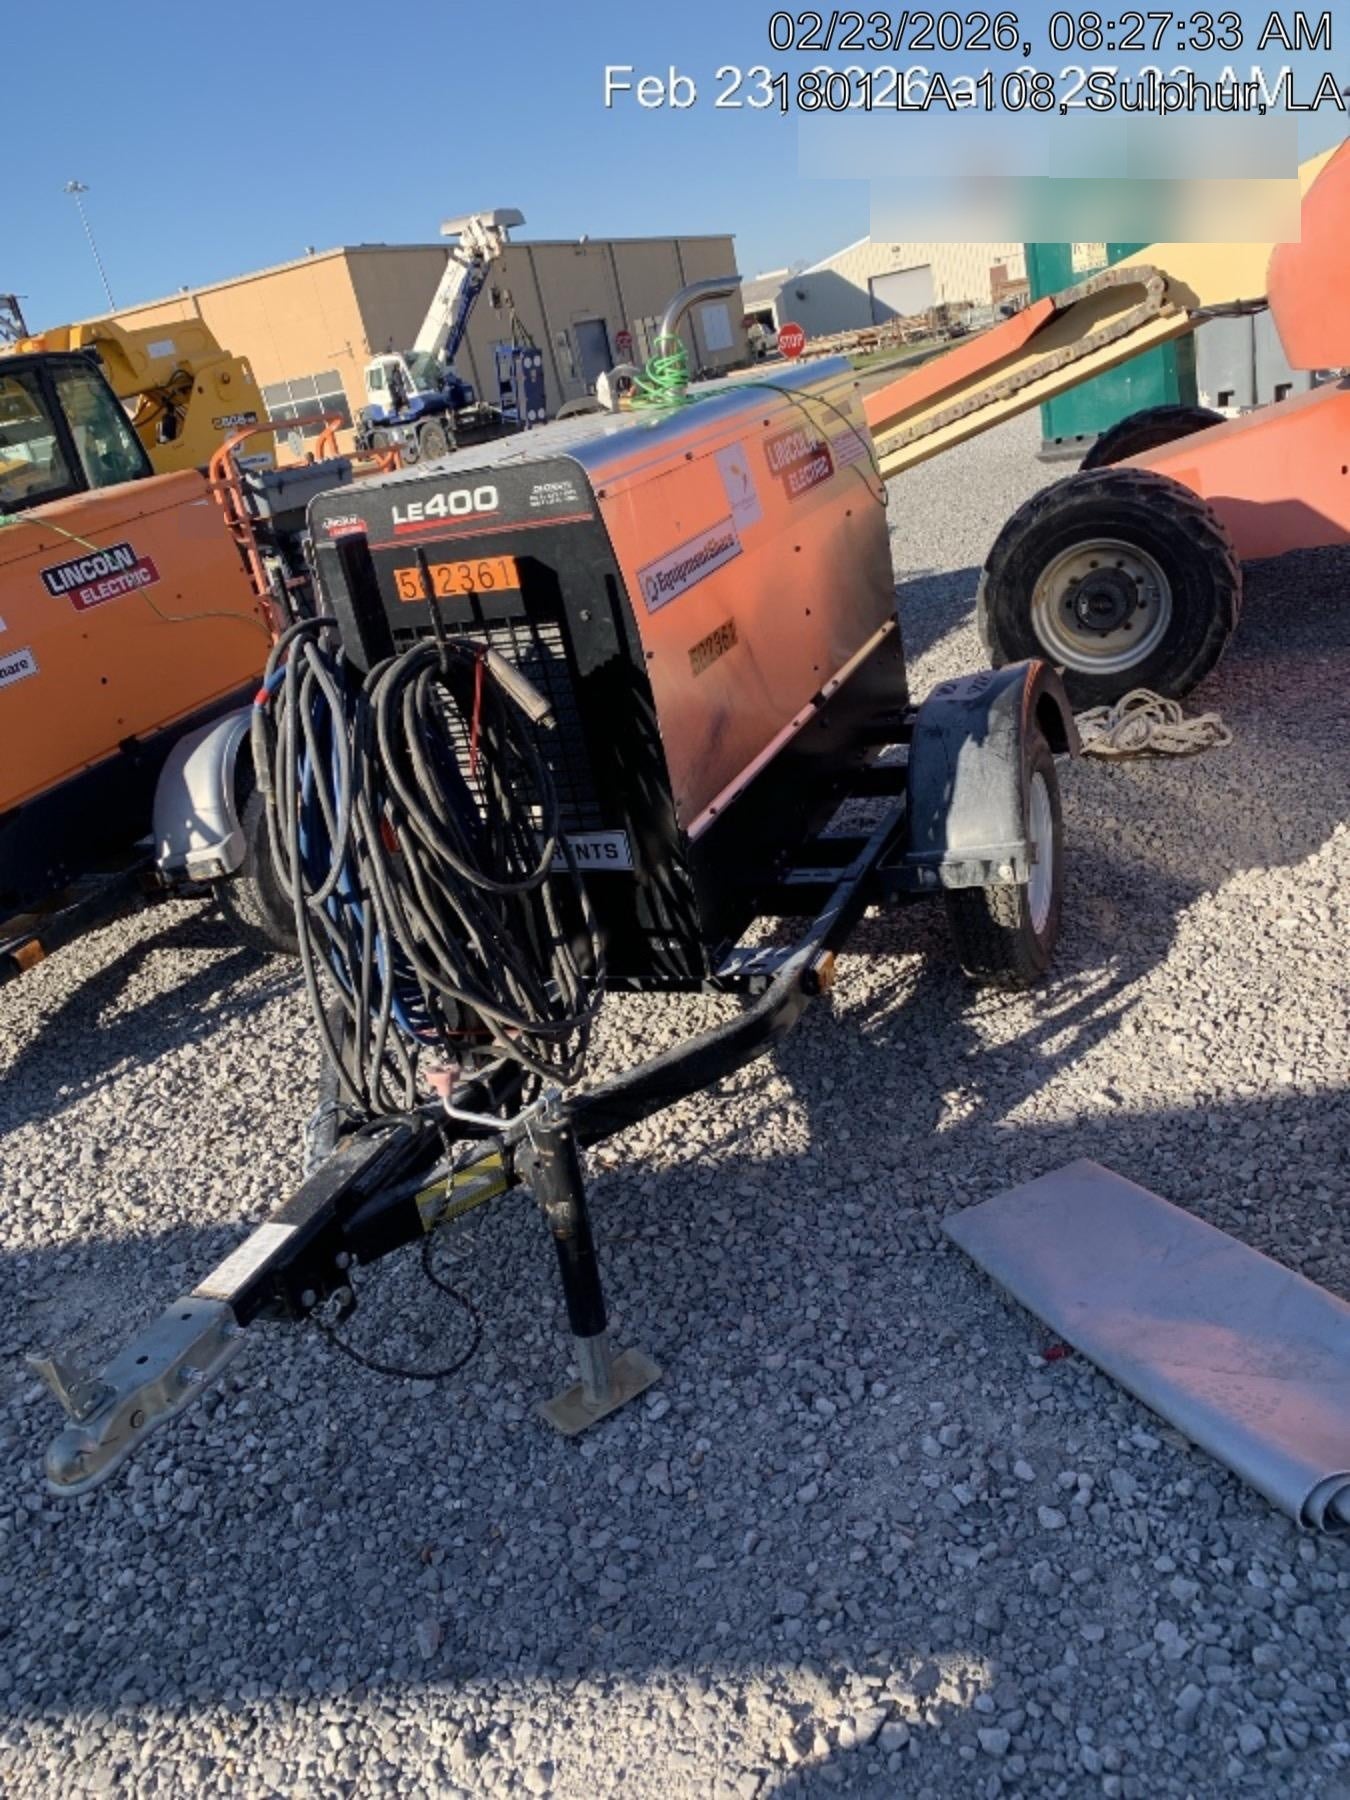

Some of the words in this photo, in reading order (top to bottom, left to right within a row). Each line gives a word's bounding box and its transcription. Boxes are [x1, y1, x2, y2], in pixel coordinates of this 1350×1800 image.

[779, 334, 803, 349] STOP
[392, 485, 499, 525] LE400
[46, 547, 135, 593] LINCOLN
[79, 567, 152, 605] ELECTRIC
[399, 559, 513, 599] 52361
